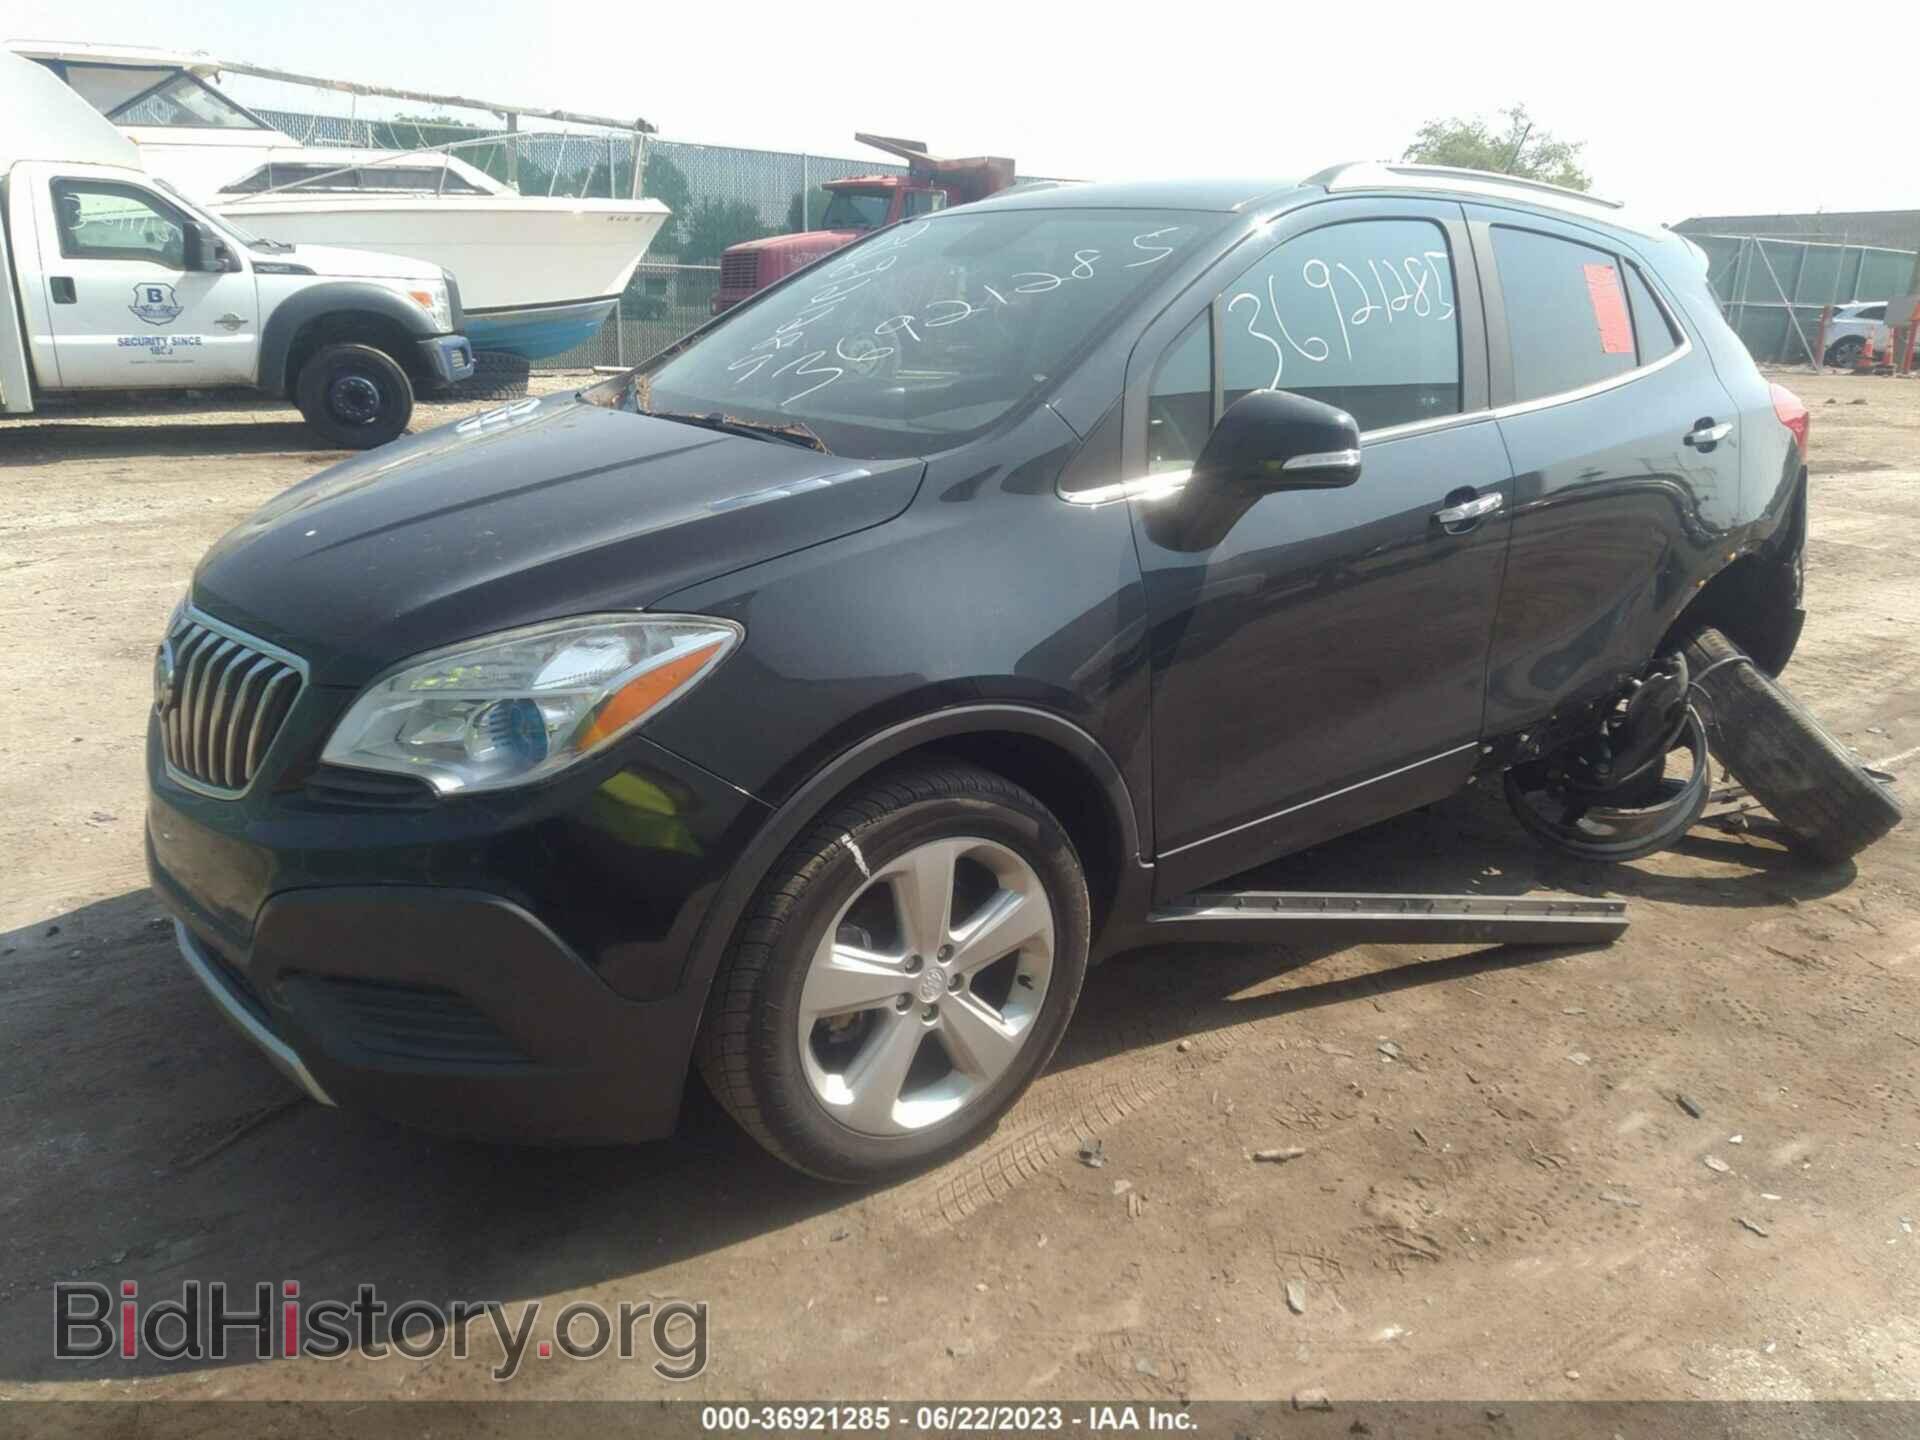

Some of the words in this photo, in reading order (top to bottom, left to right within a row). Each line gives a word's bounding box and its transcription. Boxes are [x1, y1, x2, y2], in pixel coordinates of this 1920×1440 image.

[147, 288, 163, 303] B
[1227, 251, 1456, 392] 36921285
[117, 336, 168, 347] SECURITY
[171, 336, 202, 346] SINCE
